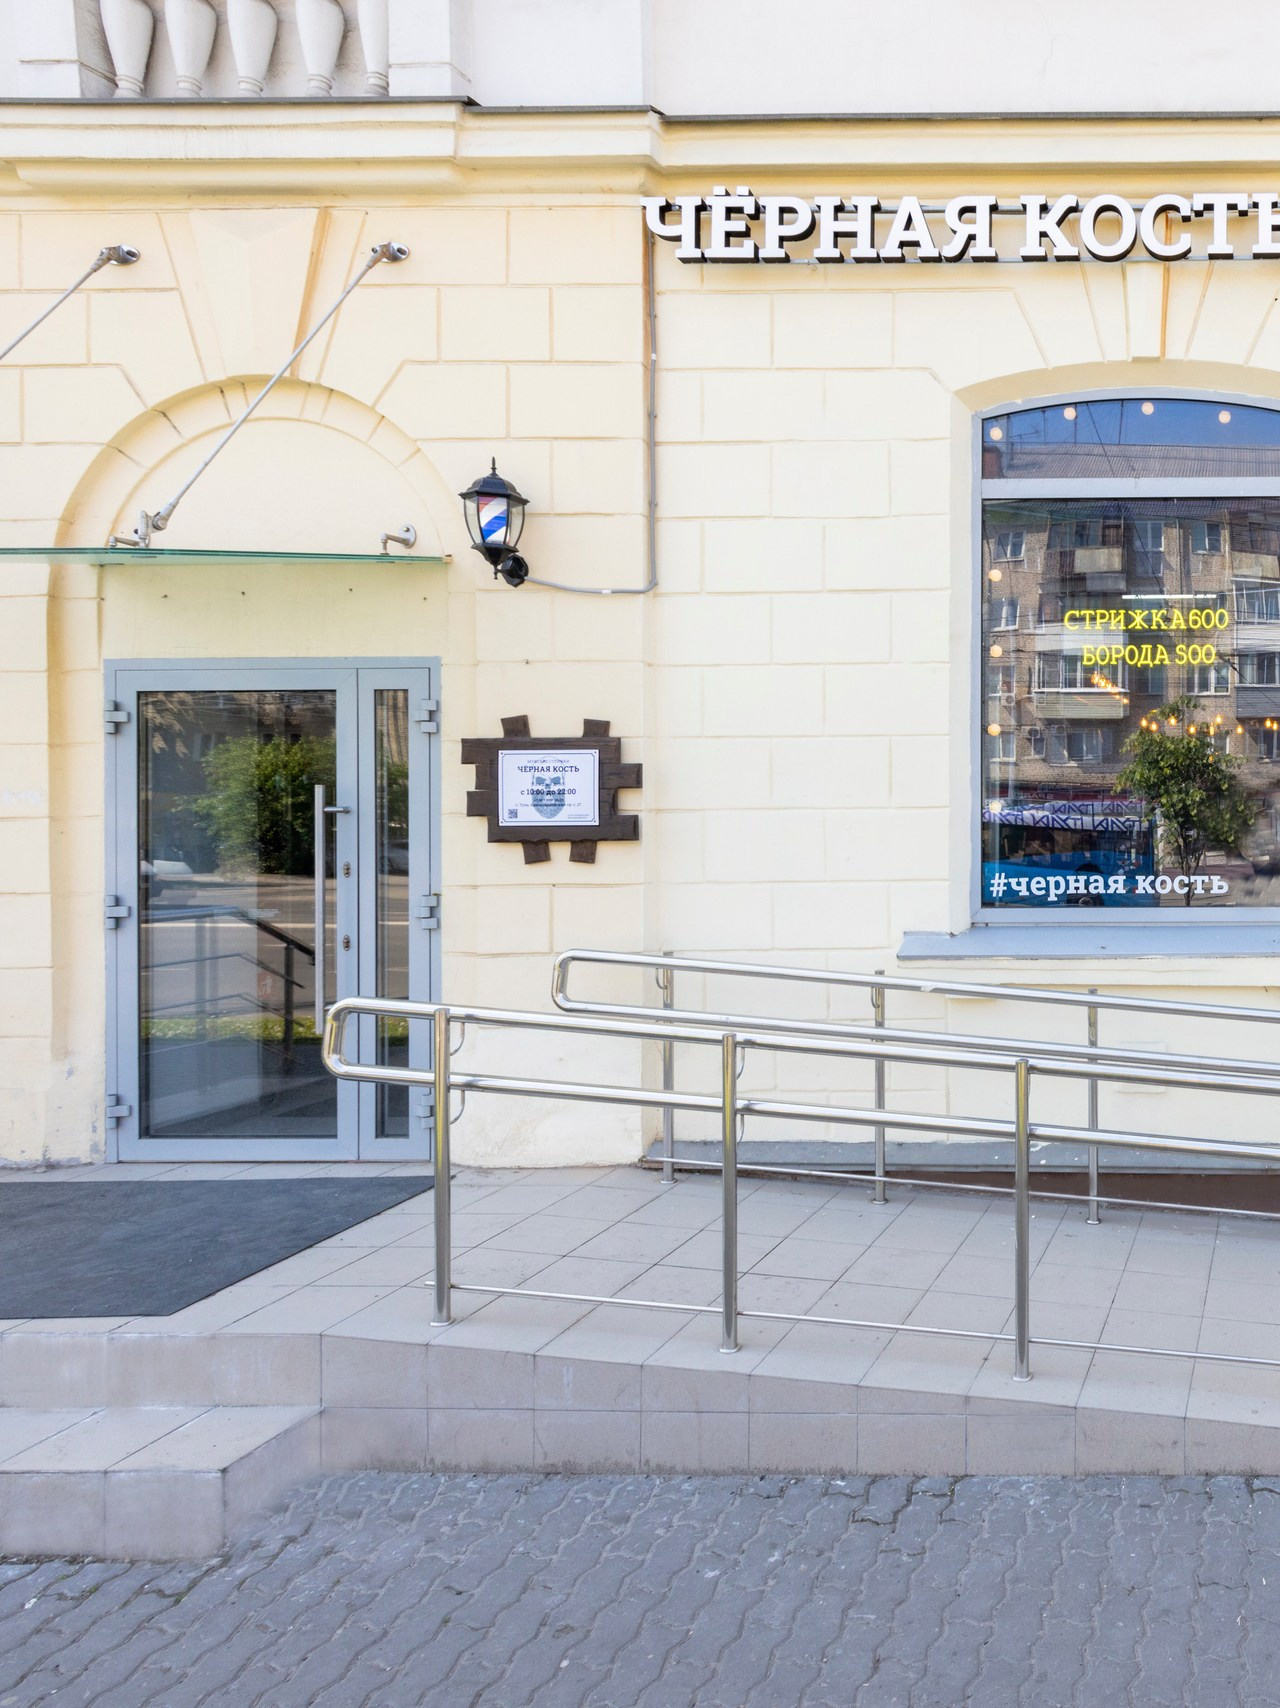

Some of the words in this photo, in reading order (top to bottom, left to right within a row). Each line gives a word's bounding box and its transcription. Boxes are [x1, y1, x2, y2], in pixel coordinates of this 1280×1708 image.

[640, 185, 1000, 263] ЧЁРНАЯ
[1082, 643, 1171, 668] БОРОДА
[1174, 643, 1217, 665] 500
[552, 765, 580, 773] КОСТЬ
[526, 788, 545, 796] 10:00
[989, 872, 1127, 901] #черная
[1135, 875, 1229, 895] кость
